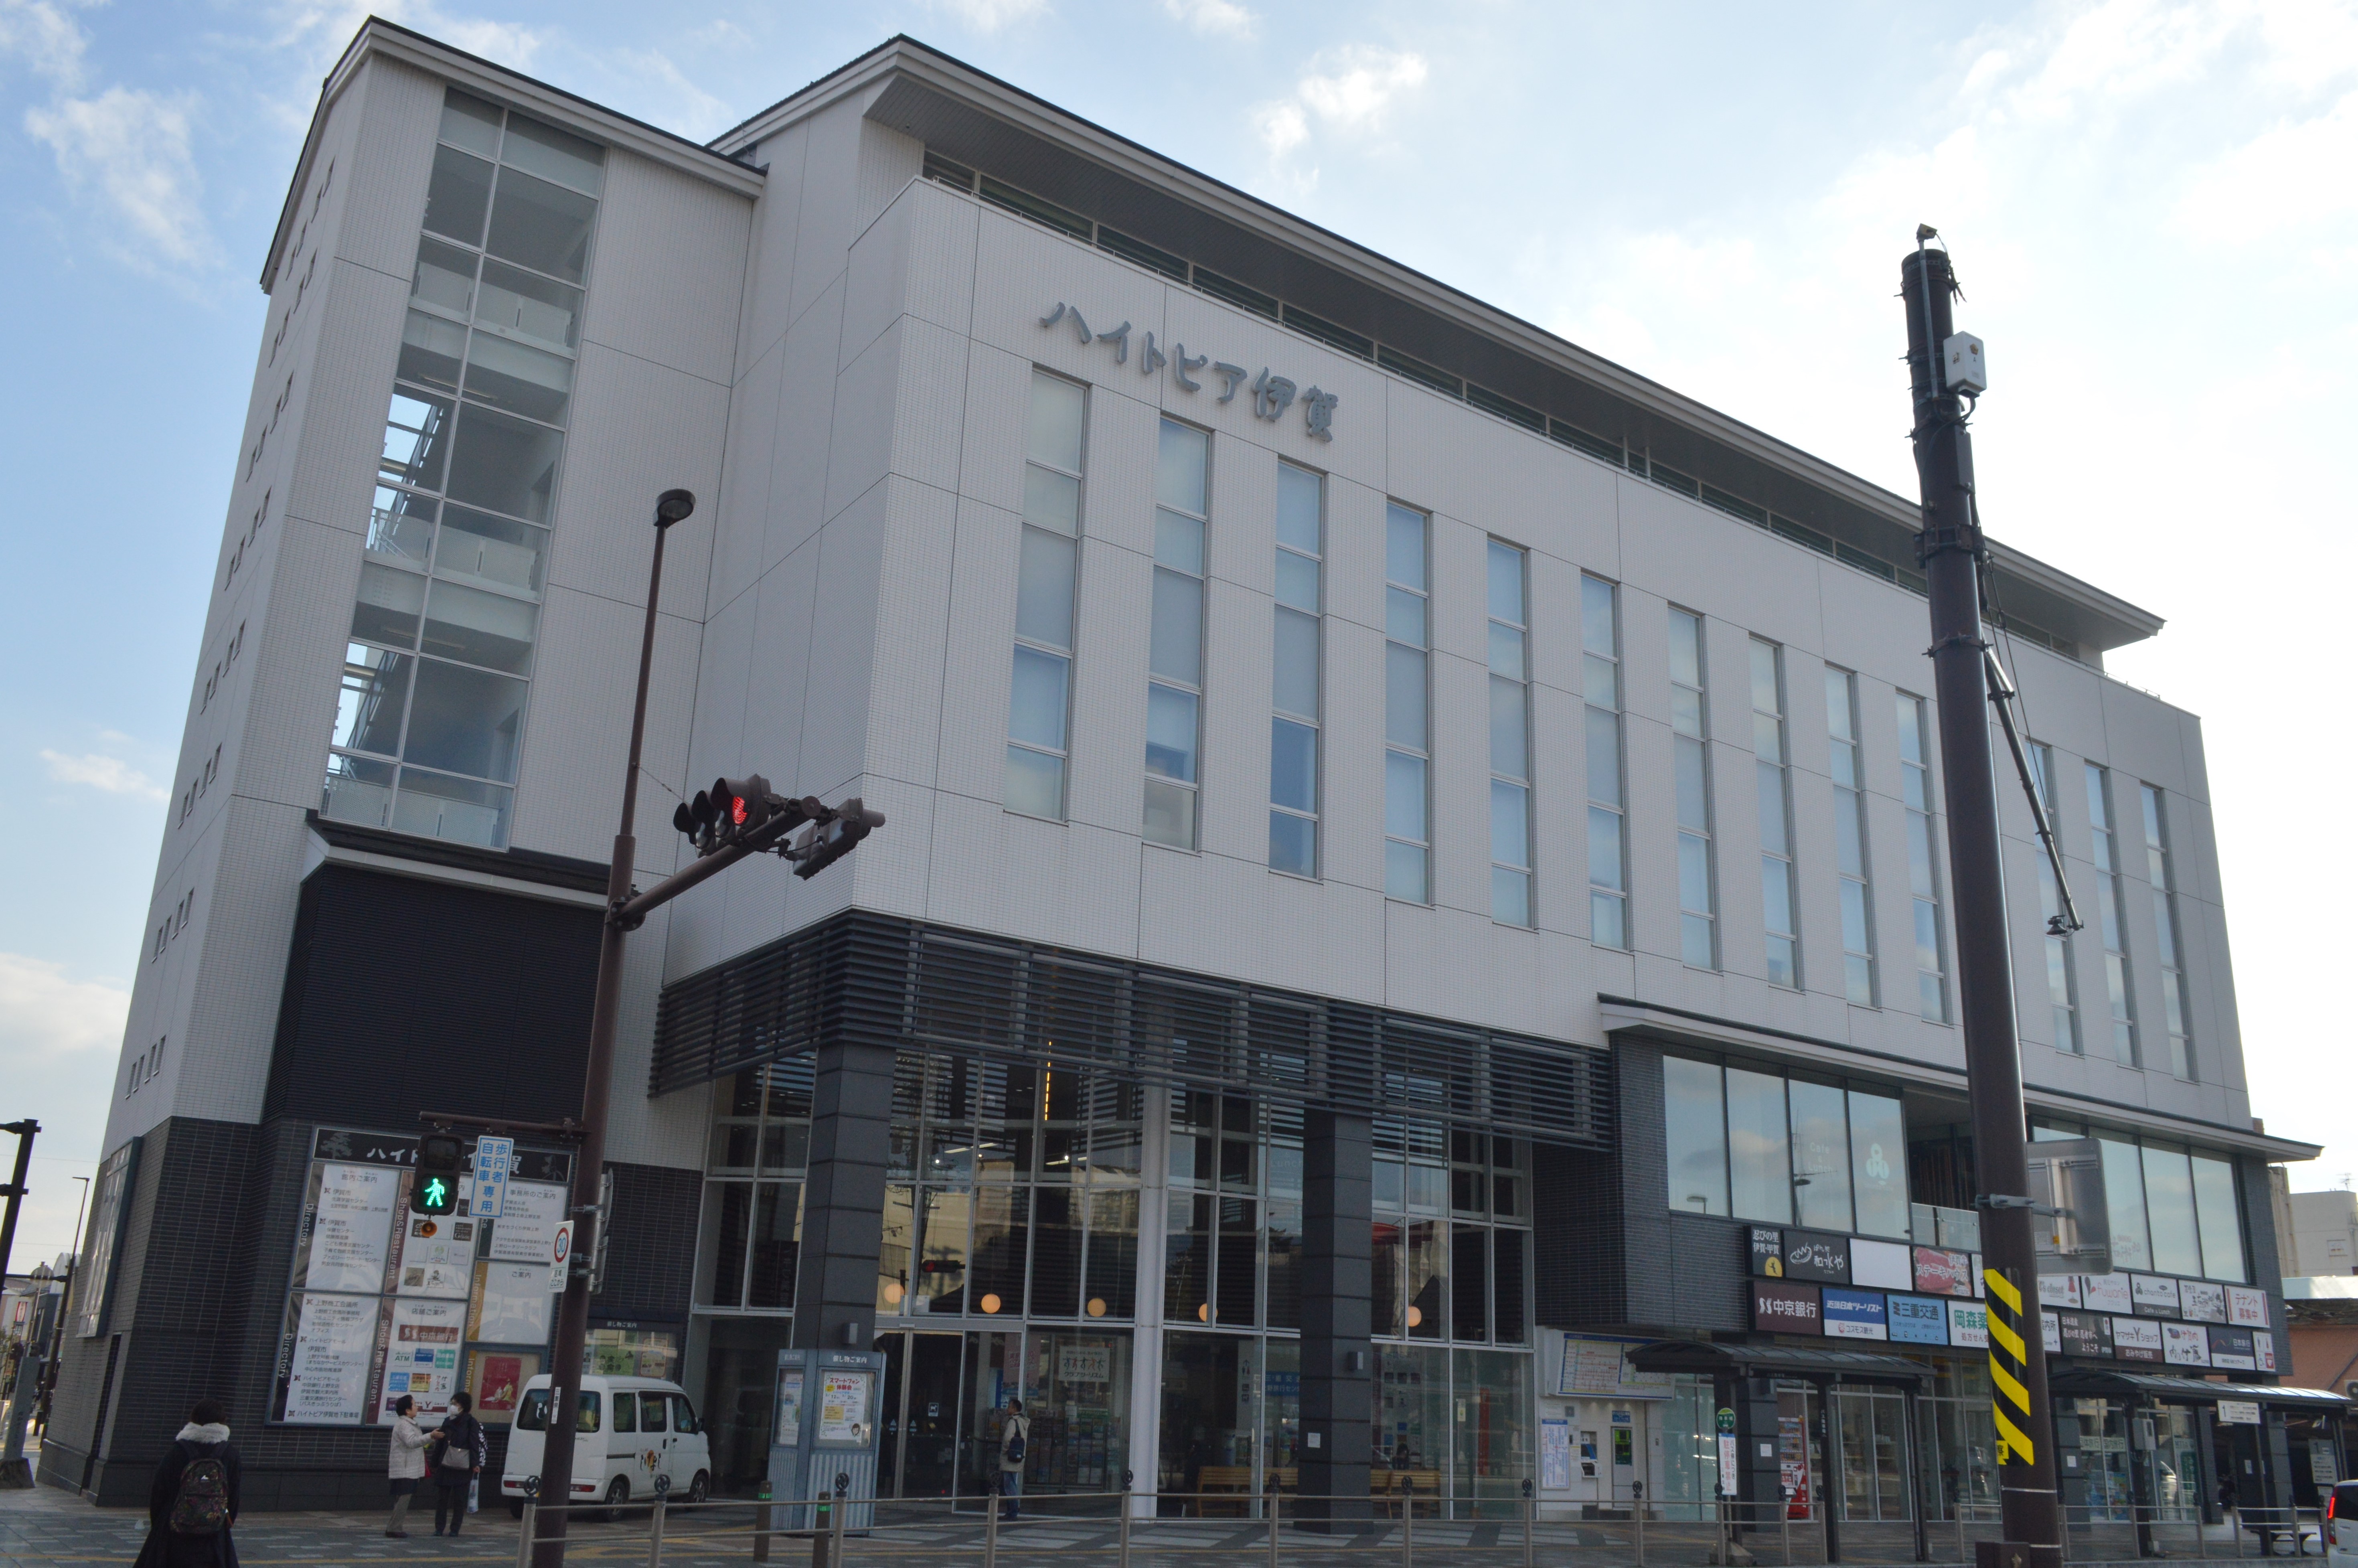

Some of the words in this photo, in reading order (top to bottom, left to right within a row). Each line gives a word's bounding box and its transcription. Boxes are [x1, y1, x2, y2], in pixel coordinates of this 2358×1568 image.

[1039, 302, 1339, 443] ハイトピア伊賀
[478, 1143, 494, 1182] 自転車
[492, 1144, 507, 1183] 歩行者
[341, 1174, 377, 1183] 館内ご案内
[480, 1185, 495, 1212] 専用
[510, 1189, 556, 1199] 事務所のご案内
[301, 1203, 314, 1247] Directory
[389, 1197, 407, 1279] Shop&Restaurant
[1753, 1229, 1779, 1242] 忍びの里
[557, 1237, 566, 1253] 30
[1916, 1264, 1968, 1282] ステーキハウス
[2097, 1282, 2128, 1299] fuwarie
[2164, 1290, 2176, 1299] cafe
[315, 1299, 359, 1308] 上野商工会議所
[469, 1275, 481, 1327] Information
[1827, 1300, 1882, 1312] 近畿日本ツーリスト
[2235, 1293, 2258, 1307] テナント
[411, 1308, 446, 1316] 店舗ご案内
[1773, 1299, 1816, 1318] 中京銀行
[1901, 1303, 1939, 1320] 三重交通
[2239, 1308, 2257, 1321] 募集中
[420, 1332, 453, 1341] 中京銀行
[278, 1333, 293, 1378] Directory
[2082, 1343, 2099, 1352] ようこそ
[370, 1320, 389, 1404] Shop&Restaurant
[833, 1355, 867, 1363] 催し物ご案内
[297, 1410, 359, 1418] ハイトピア伊賀地下駐車場
